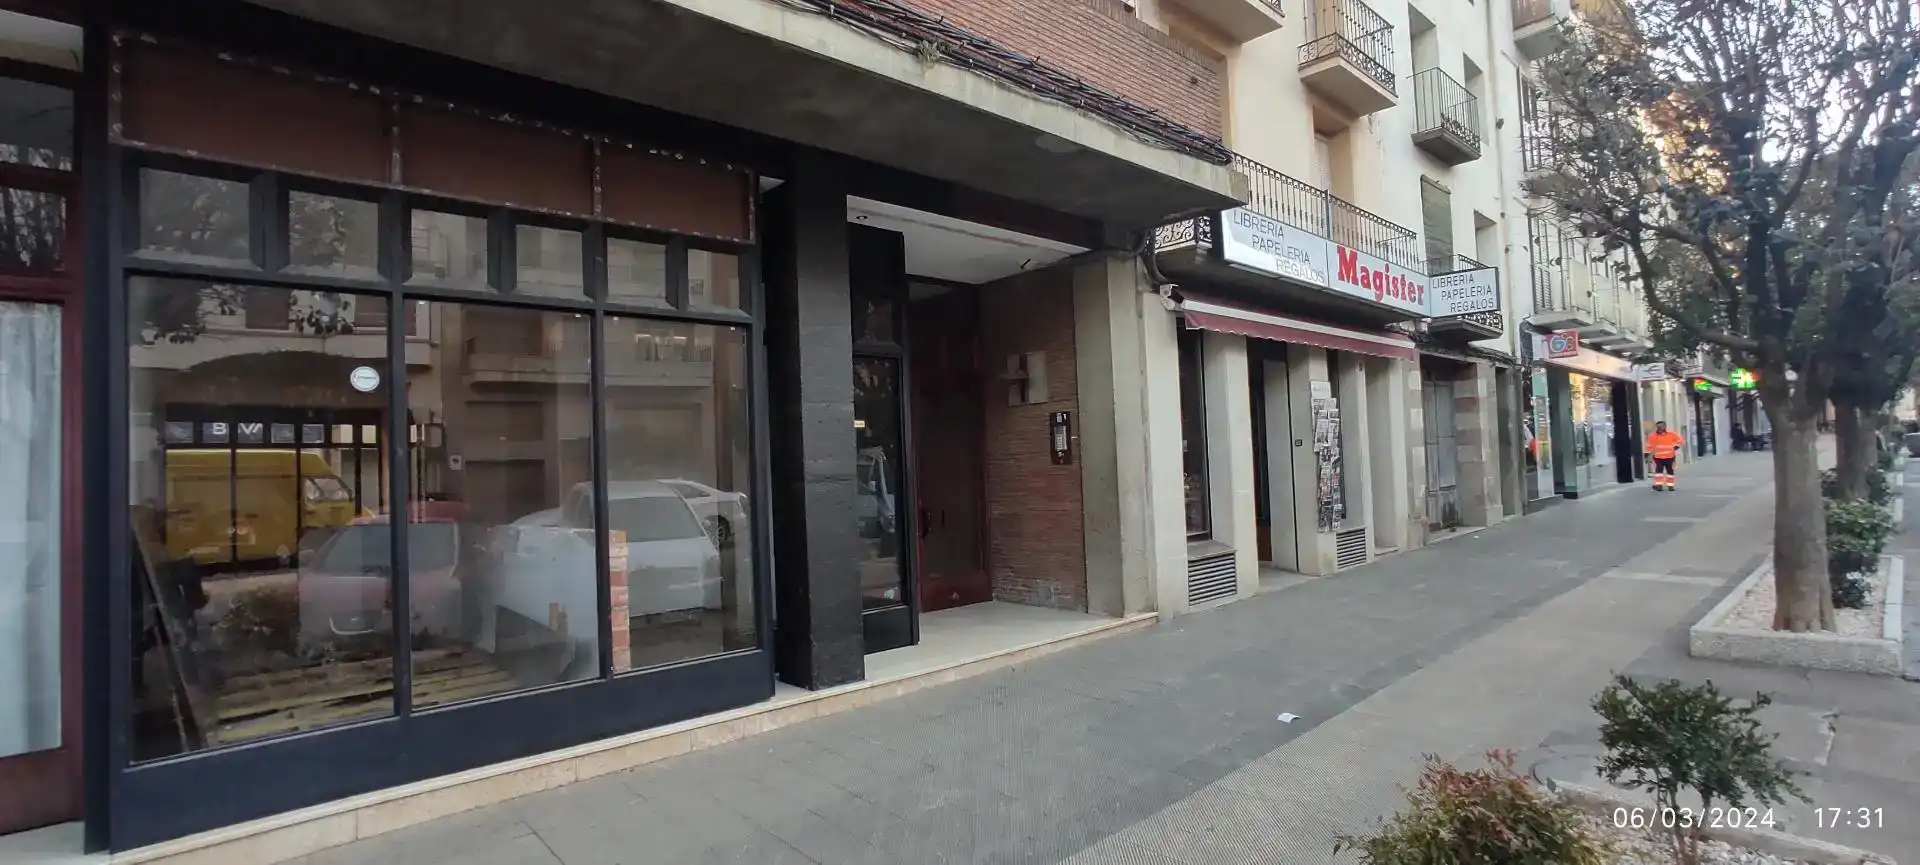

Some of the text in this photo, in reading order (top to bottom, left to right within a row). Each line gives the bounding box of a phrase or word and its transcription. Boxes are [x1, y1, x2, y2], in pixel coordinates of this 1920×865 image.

[1233, 209, 1284, 239] LIBRERIA
[1252, 234, 1311, 265] PAPELERIA
[1276, 259, 1325, 284] REGALOS
[1336, 244, 1425, 306] Magister
[1432, 273, 1475, 289] LIBRERIA
[1441, 285, 1493, 301] PAPELERIA
[1450, 298, 1495, 313] REGALOS
